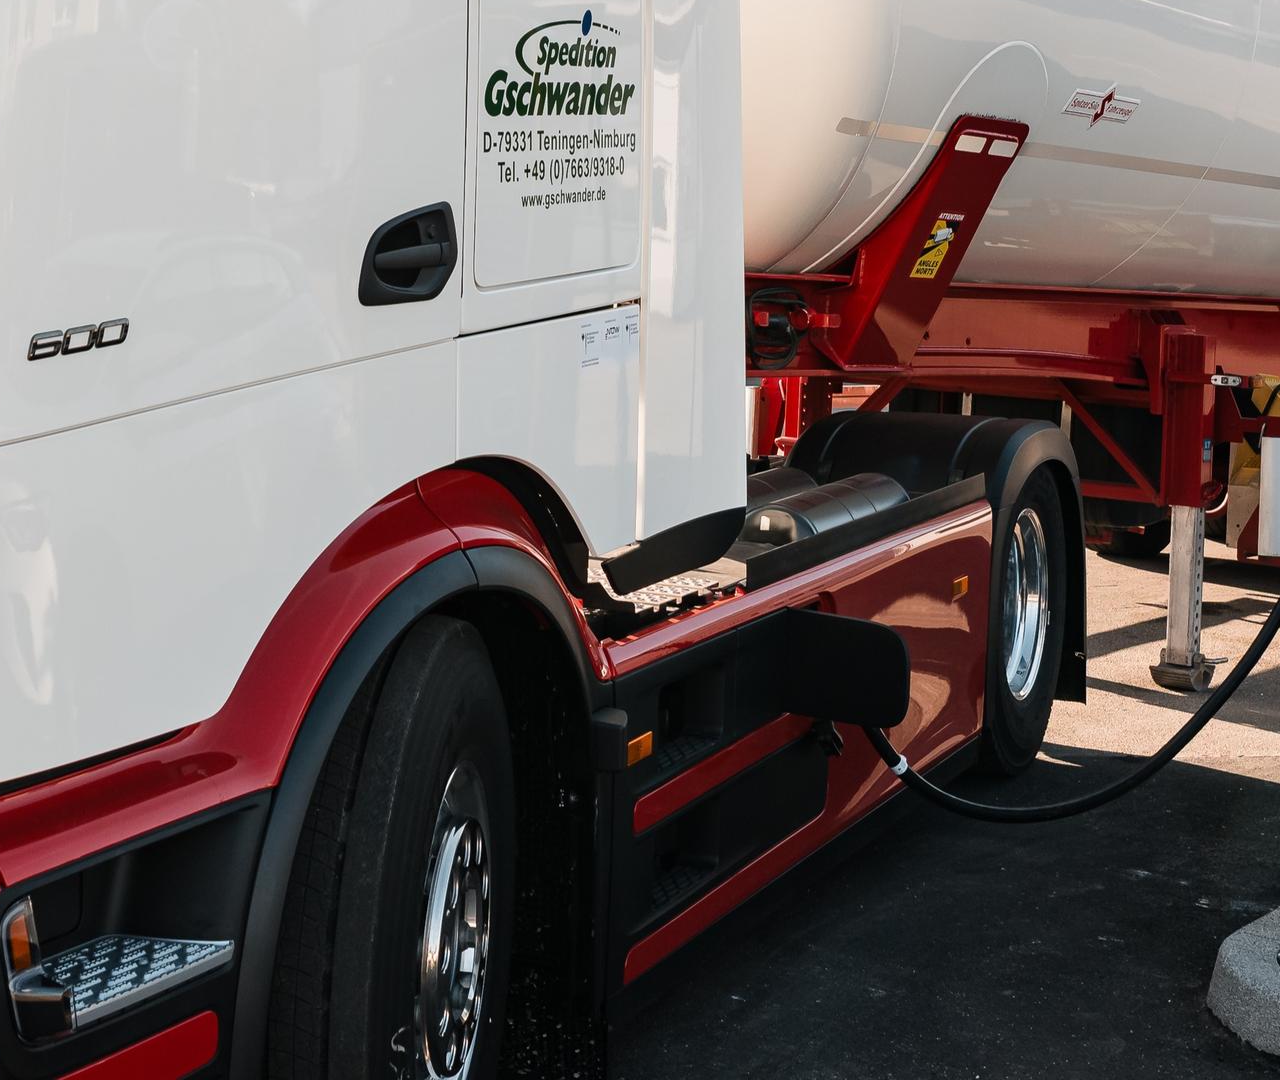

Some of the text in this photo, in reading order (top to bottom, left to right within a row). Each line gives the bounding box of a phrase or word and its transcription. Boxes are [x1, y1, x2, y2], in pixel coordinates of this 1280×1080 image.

[537, 36, 617, 75] Spedition
[484, 69, 636, 117] Gschwander
[483, 129, 636, 155] D-79331 Teningen-Nimburg
[498, 156, 625, 185] Tel. +49 (0)7663/9318-0
[521, 186, 606, 209] www.gschwander.de
[938, 212, 965, 221] ATTENTION
[915, 267, 934, 275] MORTS
[918, 260, 939, 268] ANGLES
[27, 317, 129, 362] 600
